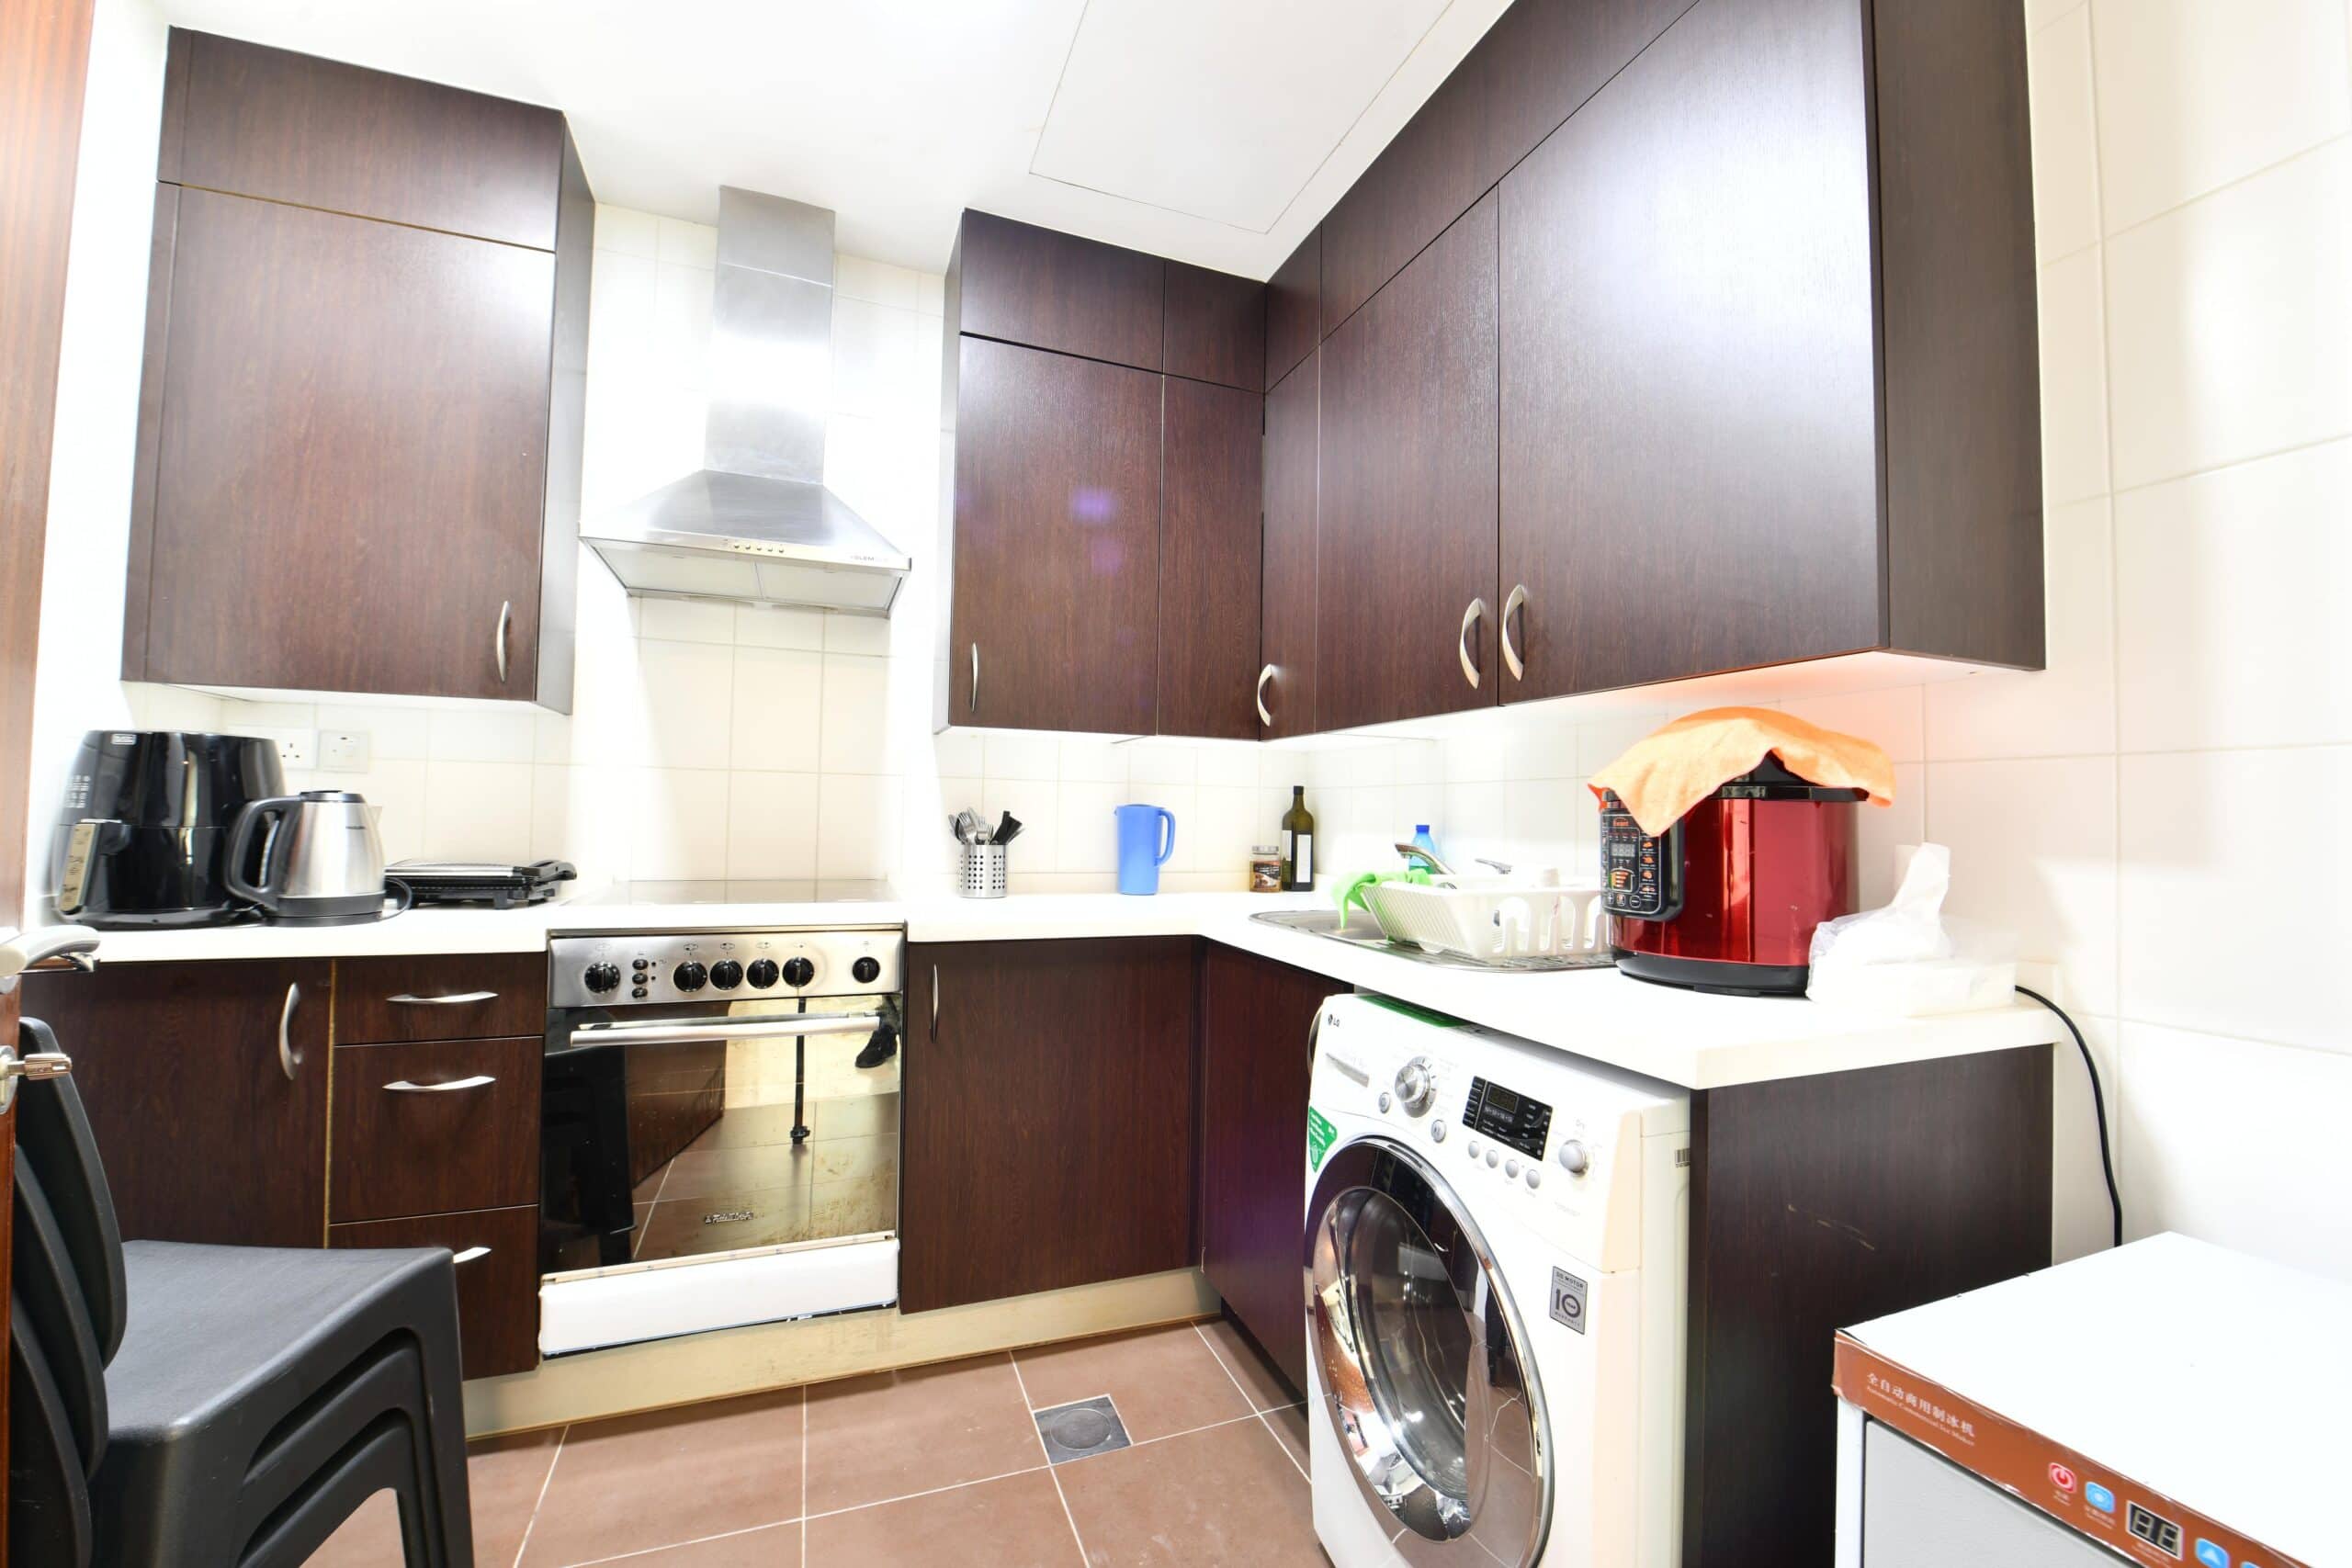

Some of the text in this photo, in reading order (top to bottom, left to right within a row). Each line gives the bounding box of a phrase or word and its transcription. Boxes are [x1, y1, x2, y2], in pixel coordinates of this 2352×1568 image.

[1333, 1017, 1340, 1028] LG
[1565, 1275, 1584, 1288] MOTOR
[1555, 1288, 1581, 1318] 10
[1867, 1372, 1975, 1438] 全自动商用制冰机
